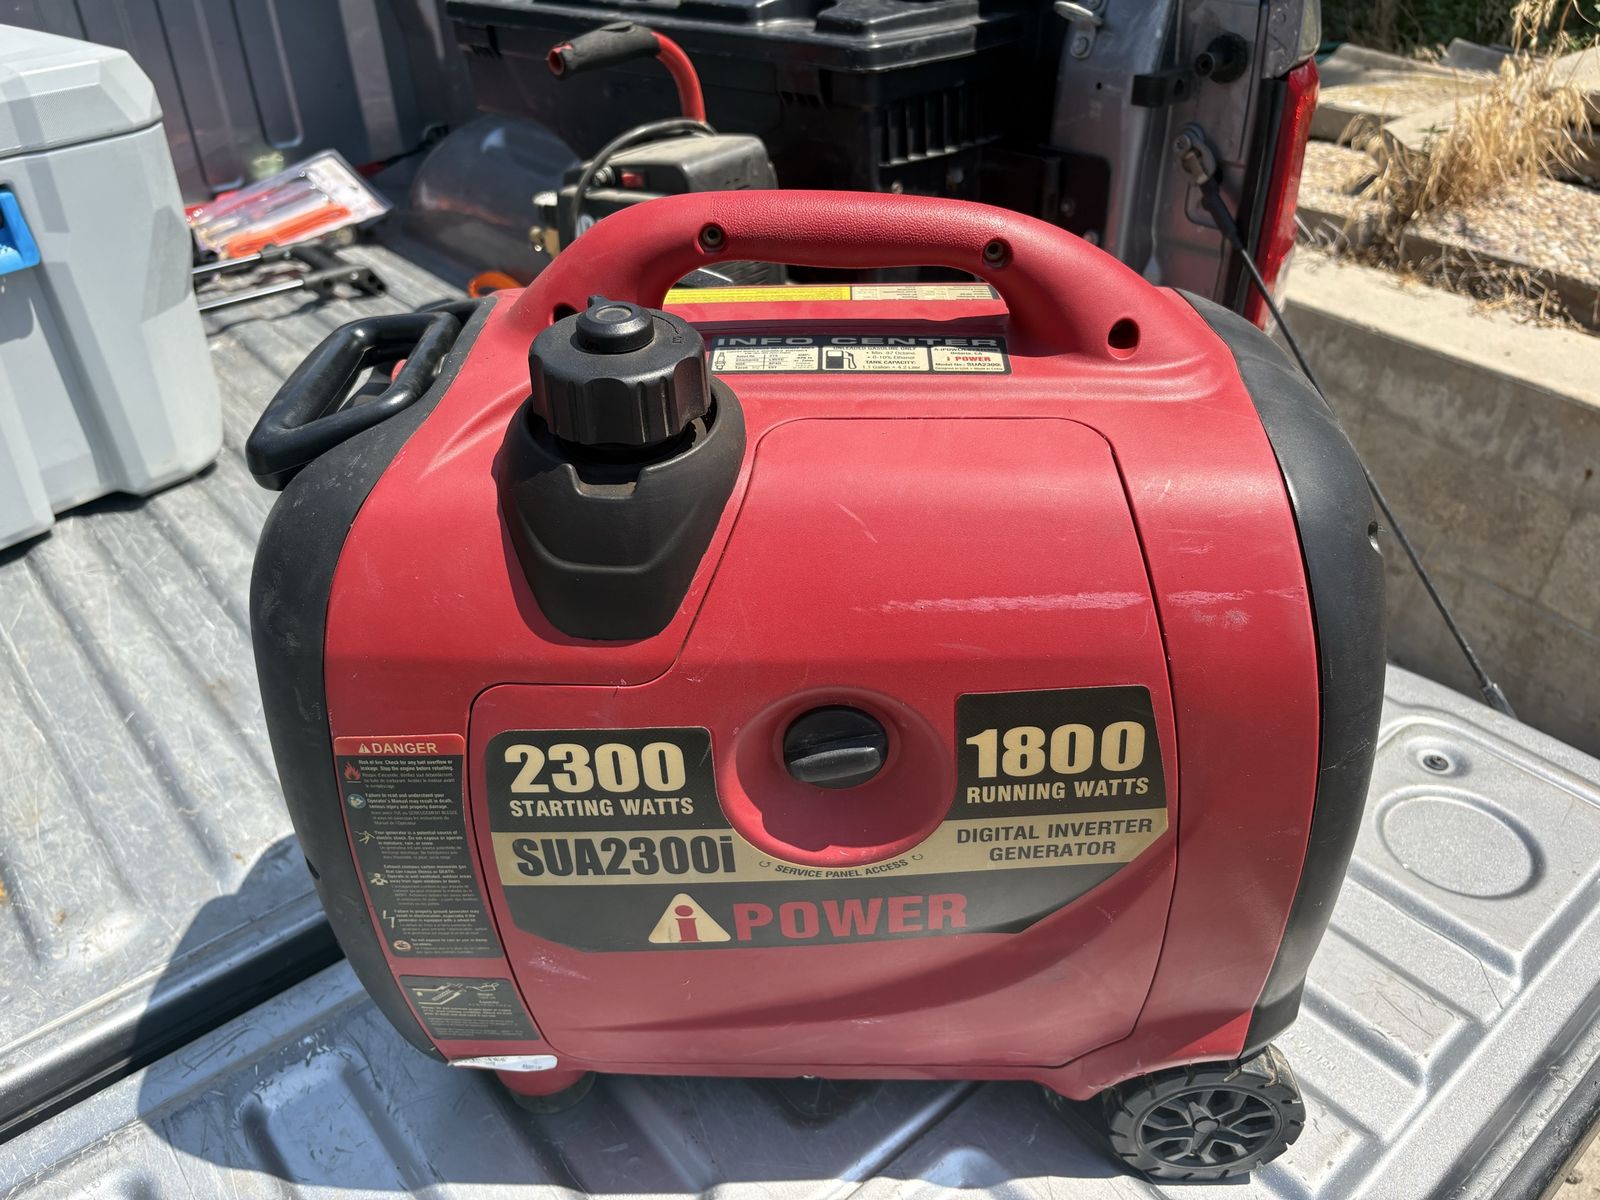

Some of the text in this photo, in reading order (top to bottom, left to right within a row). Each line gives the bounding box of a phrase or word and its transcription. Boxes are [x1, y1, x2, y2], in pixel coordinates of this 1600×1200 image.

[717, 337, 998, 346] INFO CENTER
[371, 742, 438, 754] DANGER
[966, 721, 1146, 779] 1800
[504, 742, 686, 793] 2300
[966, 777, 1149, 804] RUNNING WATTS
[510, 797, 694, 817] STARTING WATTS
[956, 818, 1153, 844] DIGITAL INVERTER
[512, 835, 736, 877] SUA2300i
[989, 841, 1116, 861] GENERATOR
[774, 859, 909, 878] SERVICE PANEL ACCESS
[733, 893, 968, 941] POWER
